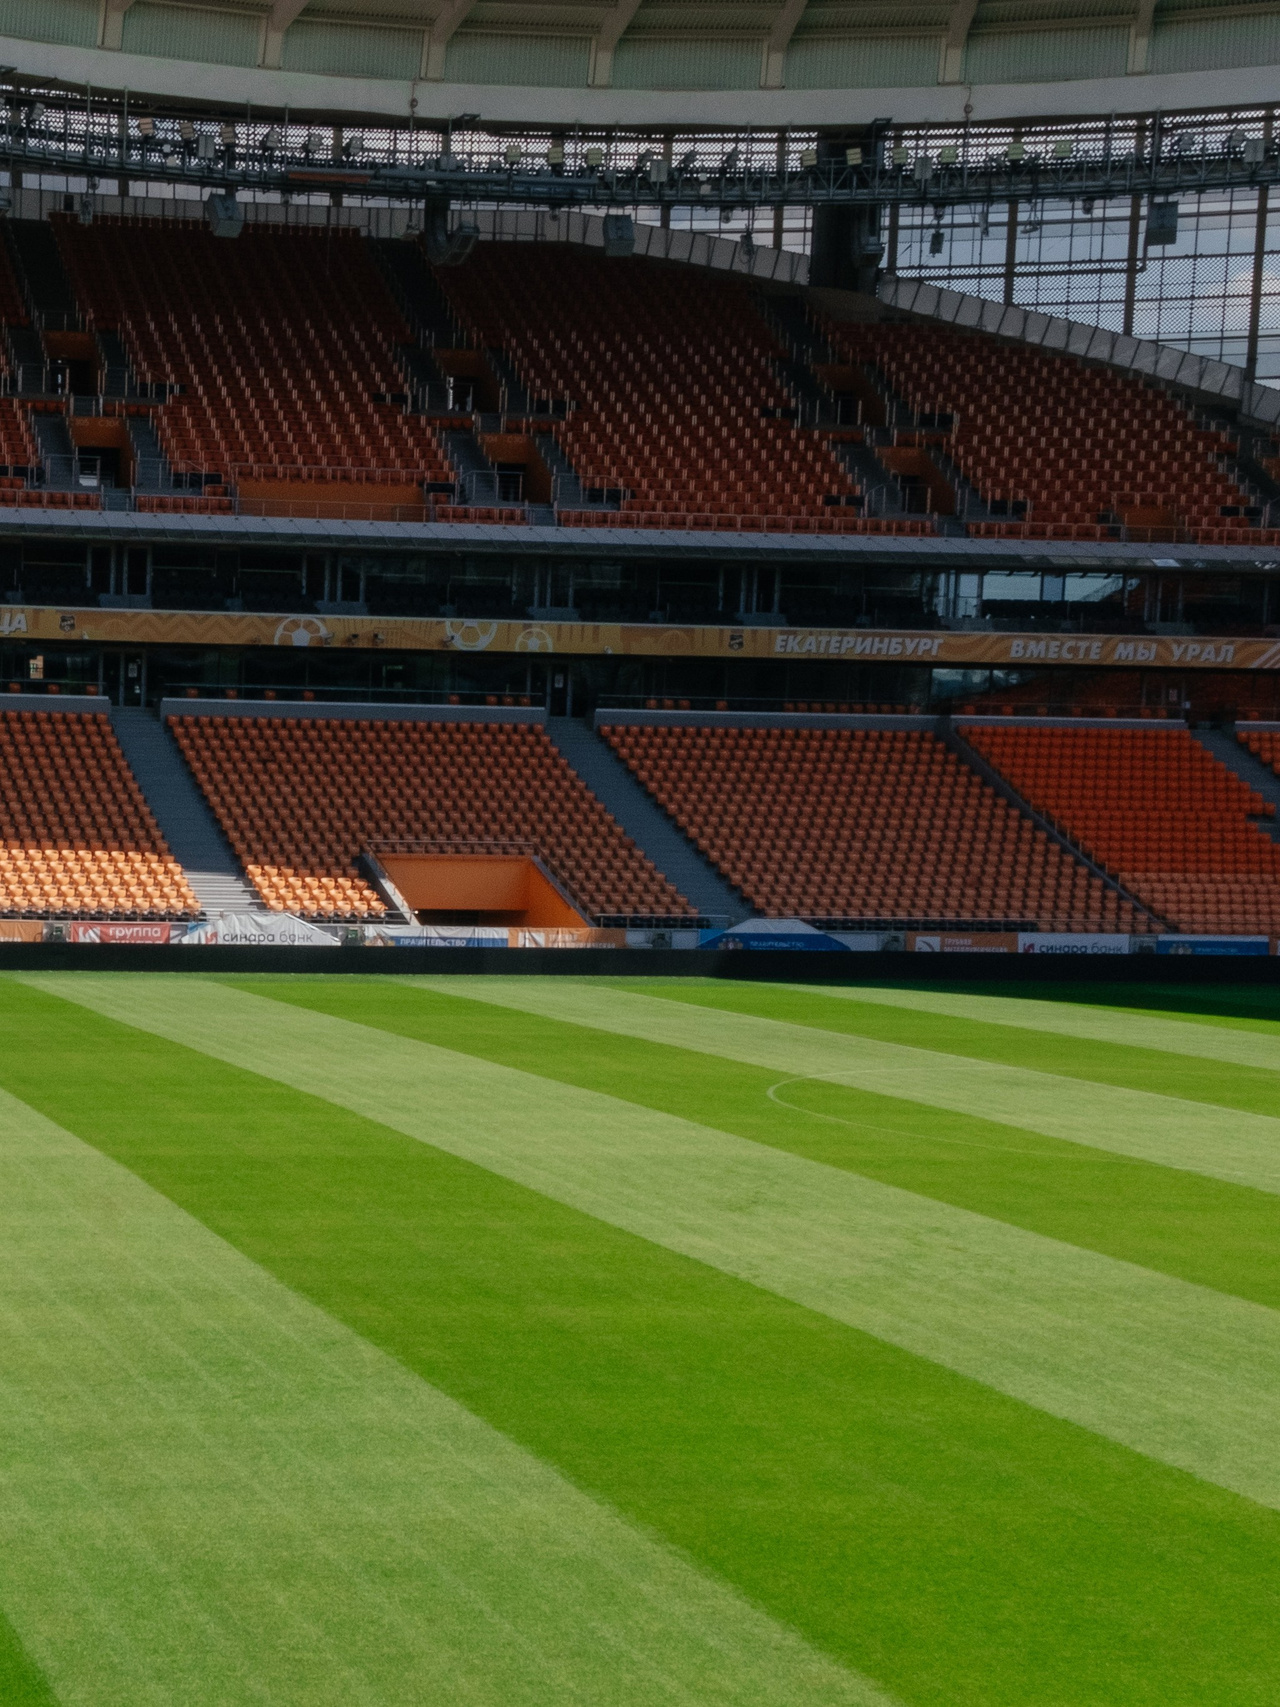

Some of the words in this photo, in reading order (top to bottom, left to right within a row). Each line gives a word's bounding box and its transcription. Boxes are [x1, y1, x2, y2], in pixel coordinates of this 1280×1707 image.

[774, 635, 944, 656] ЕКАТЕРИНБУРГ
[1009, 639, 1103, 660] ВМЕСТЕ
[1114, 642, 1157, 662] МЫ
[1171, 643, 1235, 663] УРАЛ
[109, 926, 161, 939] группа
[222, 931, 276, 945] синара
[279, 930, 314, 944] банк
[1039, 943, 1088, 953] синара
